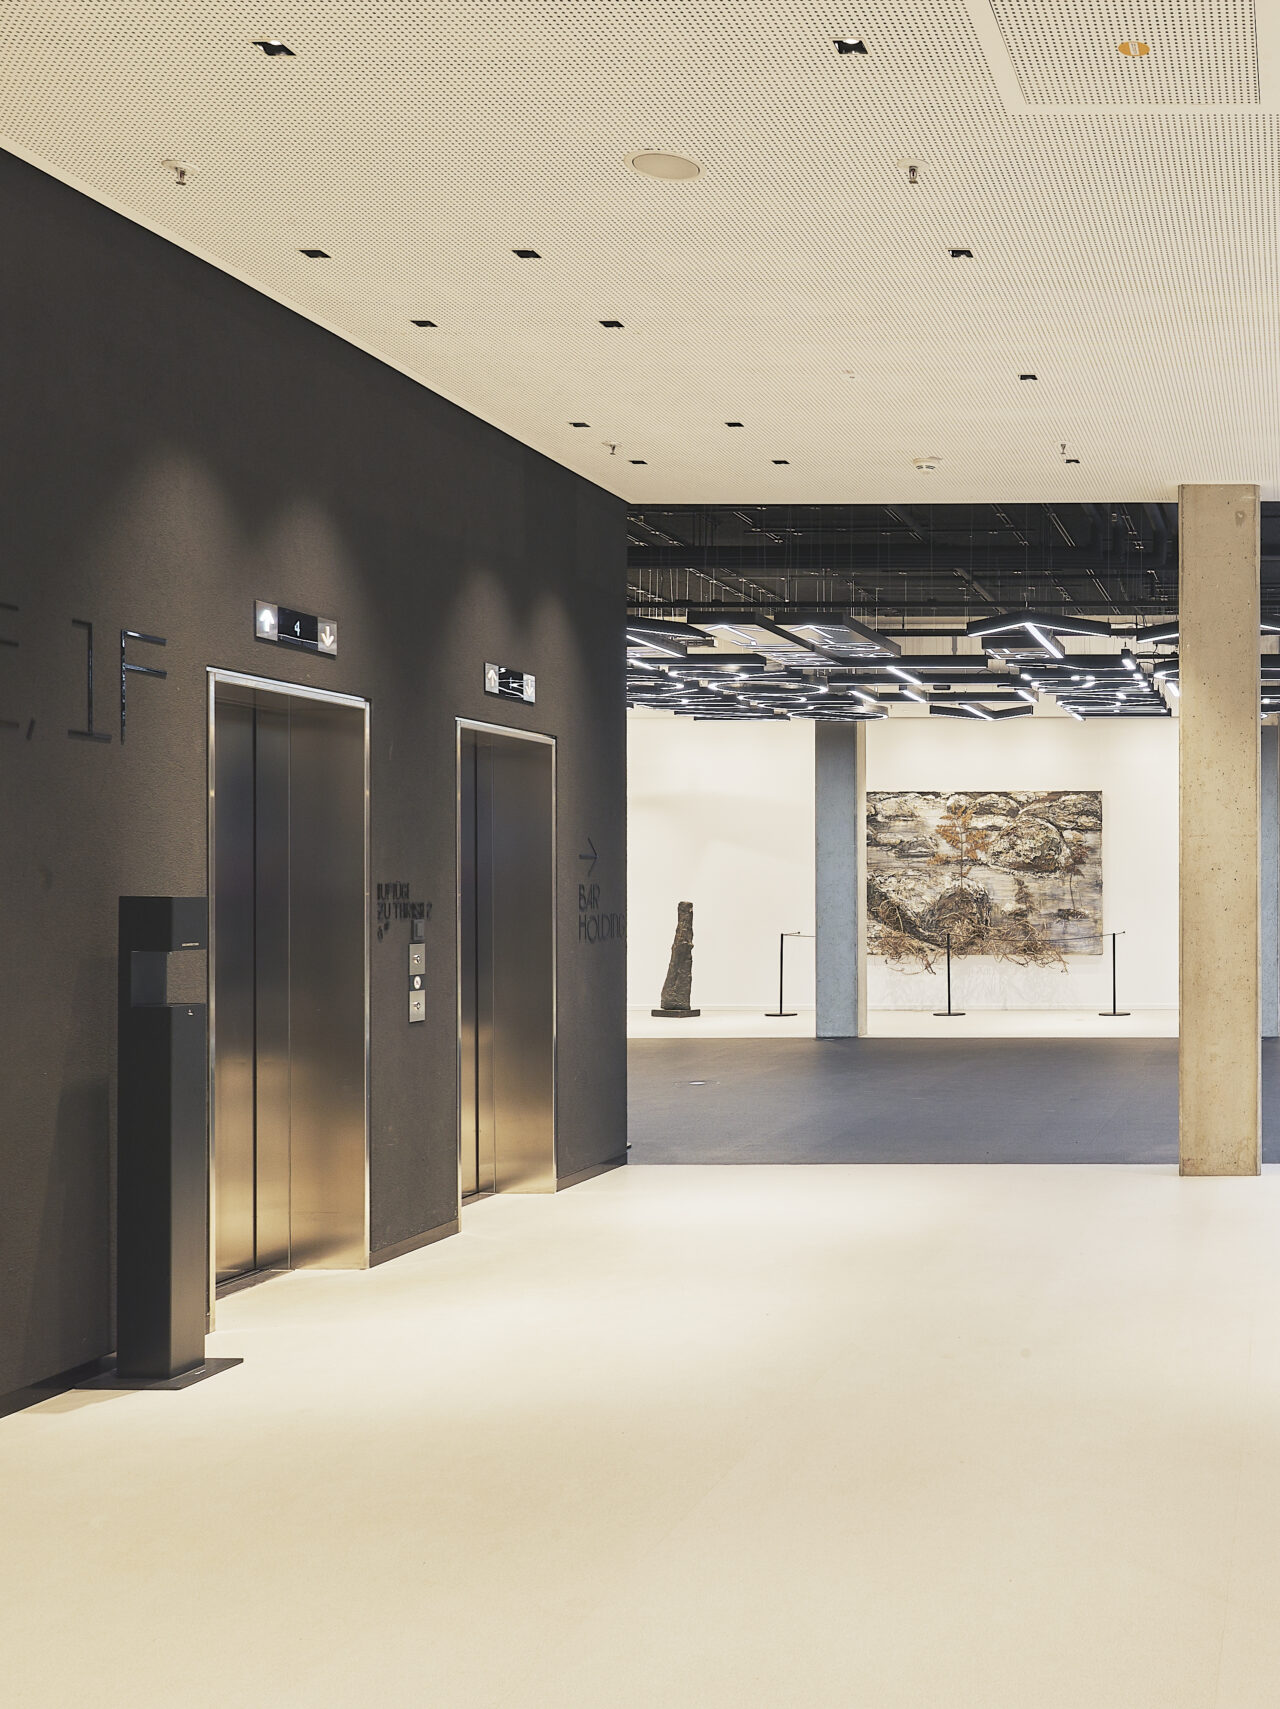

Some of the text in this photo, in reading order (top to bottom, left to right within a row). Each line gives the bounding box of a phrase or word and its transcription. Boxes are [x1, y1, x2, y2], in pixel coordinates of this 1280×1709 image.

[294, 620, 300, 637] 4
[578, 884, 601, 912] BAR
[578, 912, 626, 944] HOLDING
